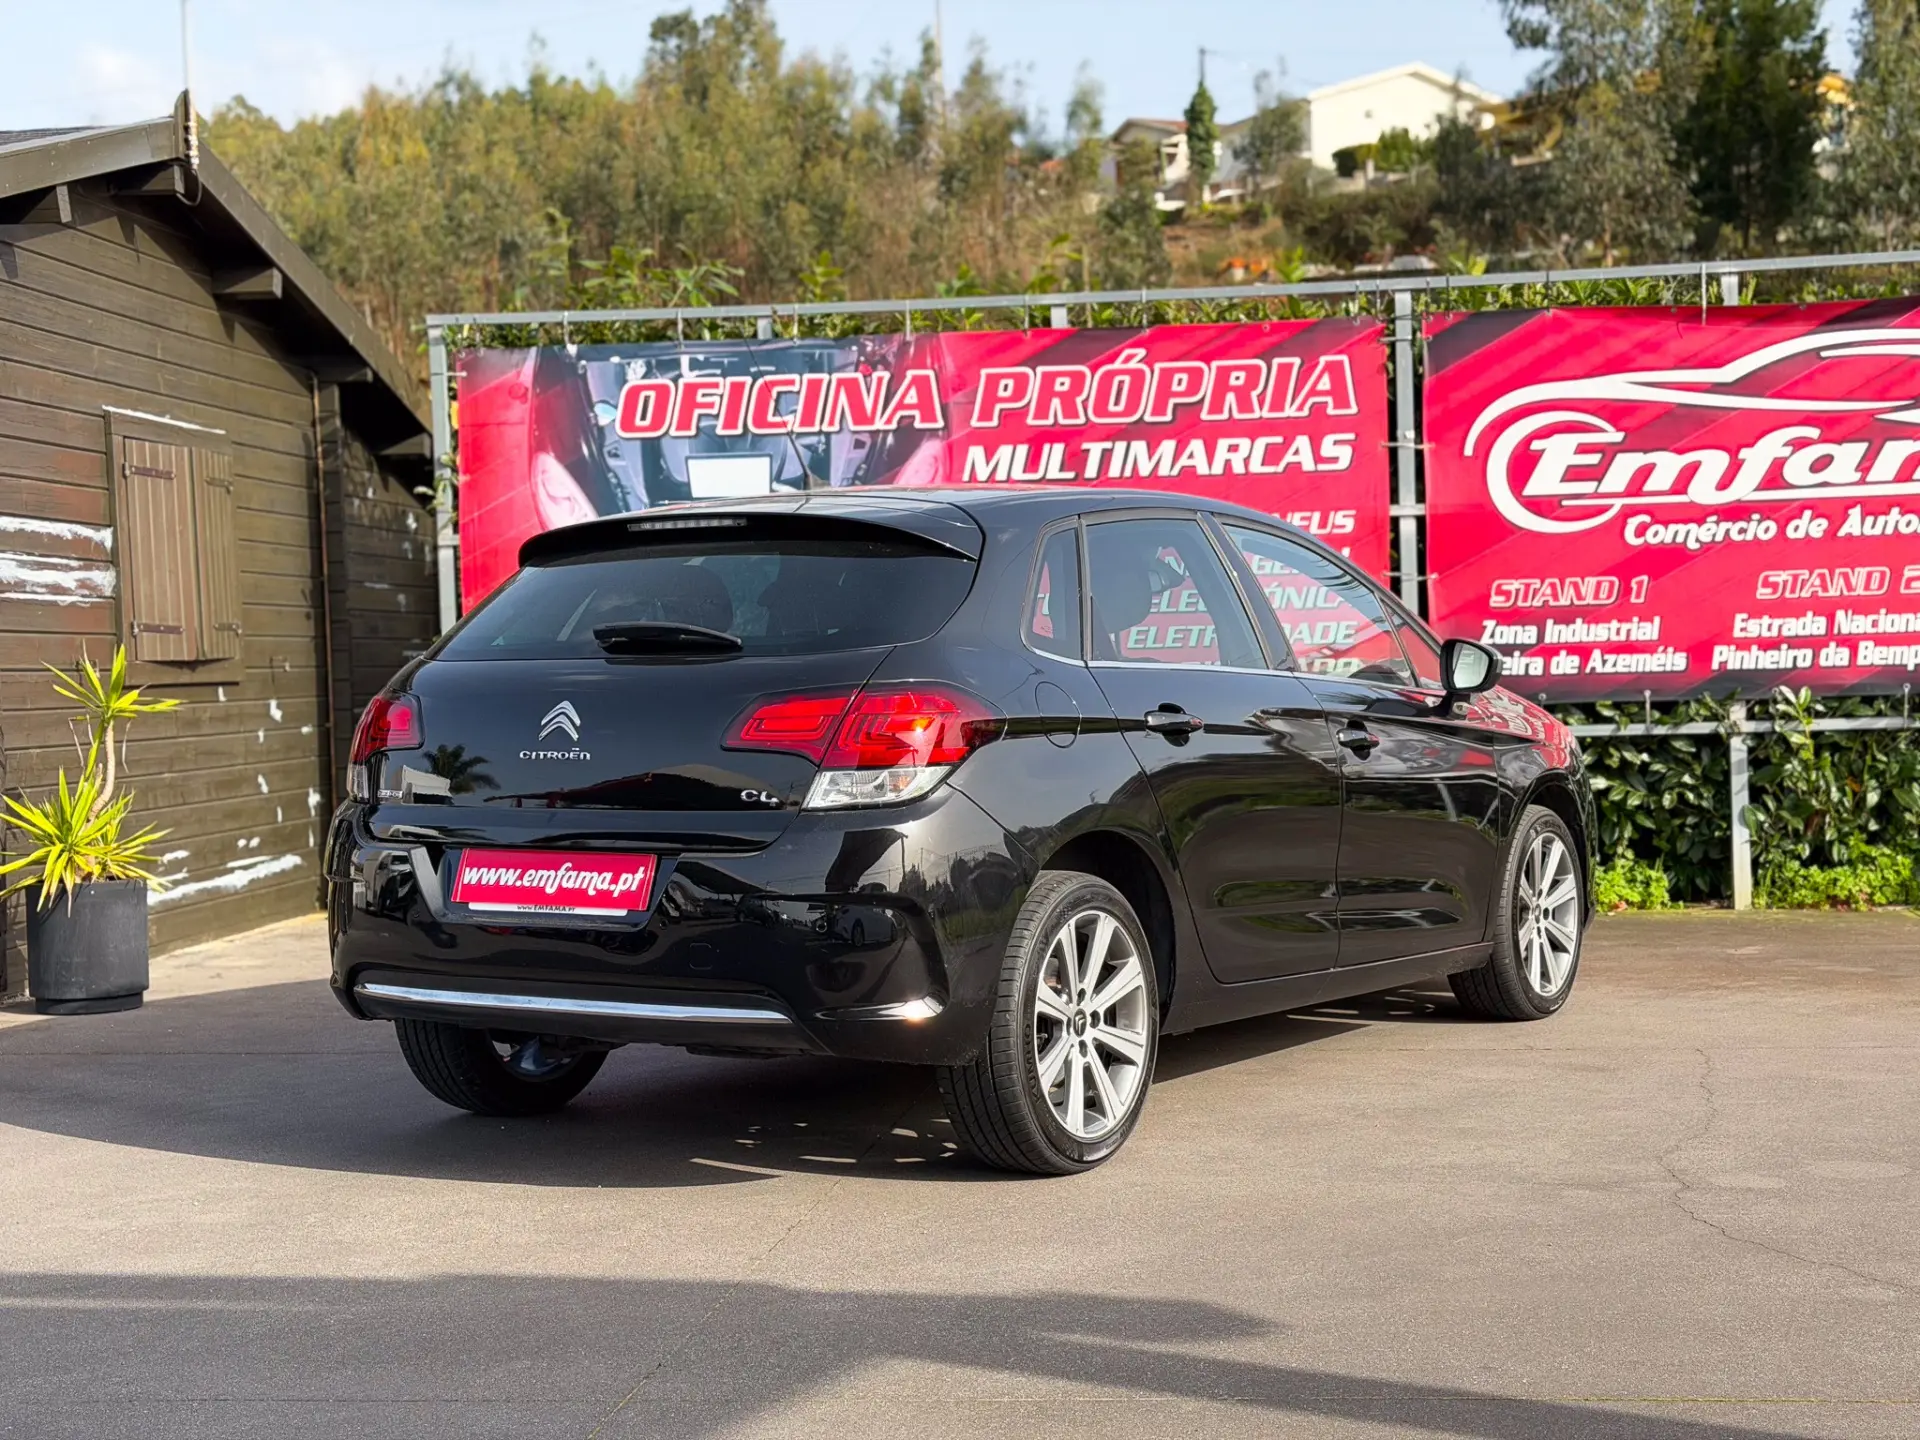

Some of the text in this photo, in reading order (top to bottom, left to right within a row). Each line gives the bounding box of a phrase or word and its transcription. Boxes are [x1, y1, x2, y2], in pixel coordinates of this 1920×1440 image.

[615, 348, 1360, 439] OFICINA PRÓPRIA
[961, 433, 1357, 483] MULTIMARCAS
[1623, 502, 1920, 551] Comércio de Auto
[1489, 574, 1650, 608] STAND 1
[1755, 566, 1891, 599] STAND
[1480, 615, 1661, 646] Zona Industrial
[1732, 610, 1828, 639] Estrada
[1550, 650, 1580, 675] de
[1585, 646, 1688, 673] Azeméis
[1711, 643, 1814, 671] Pinheiro
[1818, 641, 1851, 668] da
[740, 789, 780, 807] C4
[462, 861, 645, 898] www.emfama.pt
